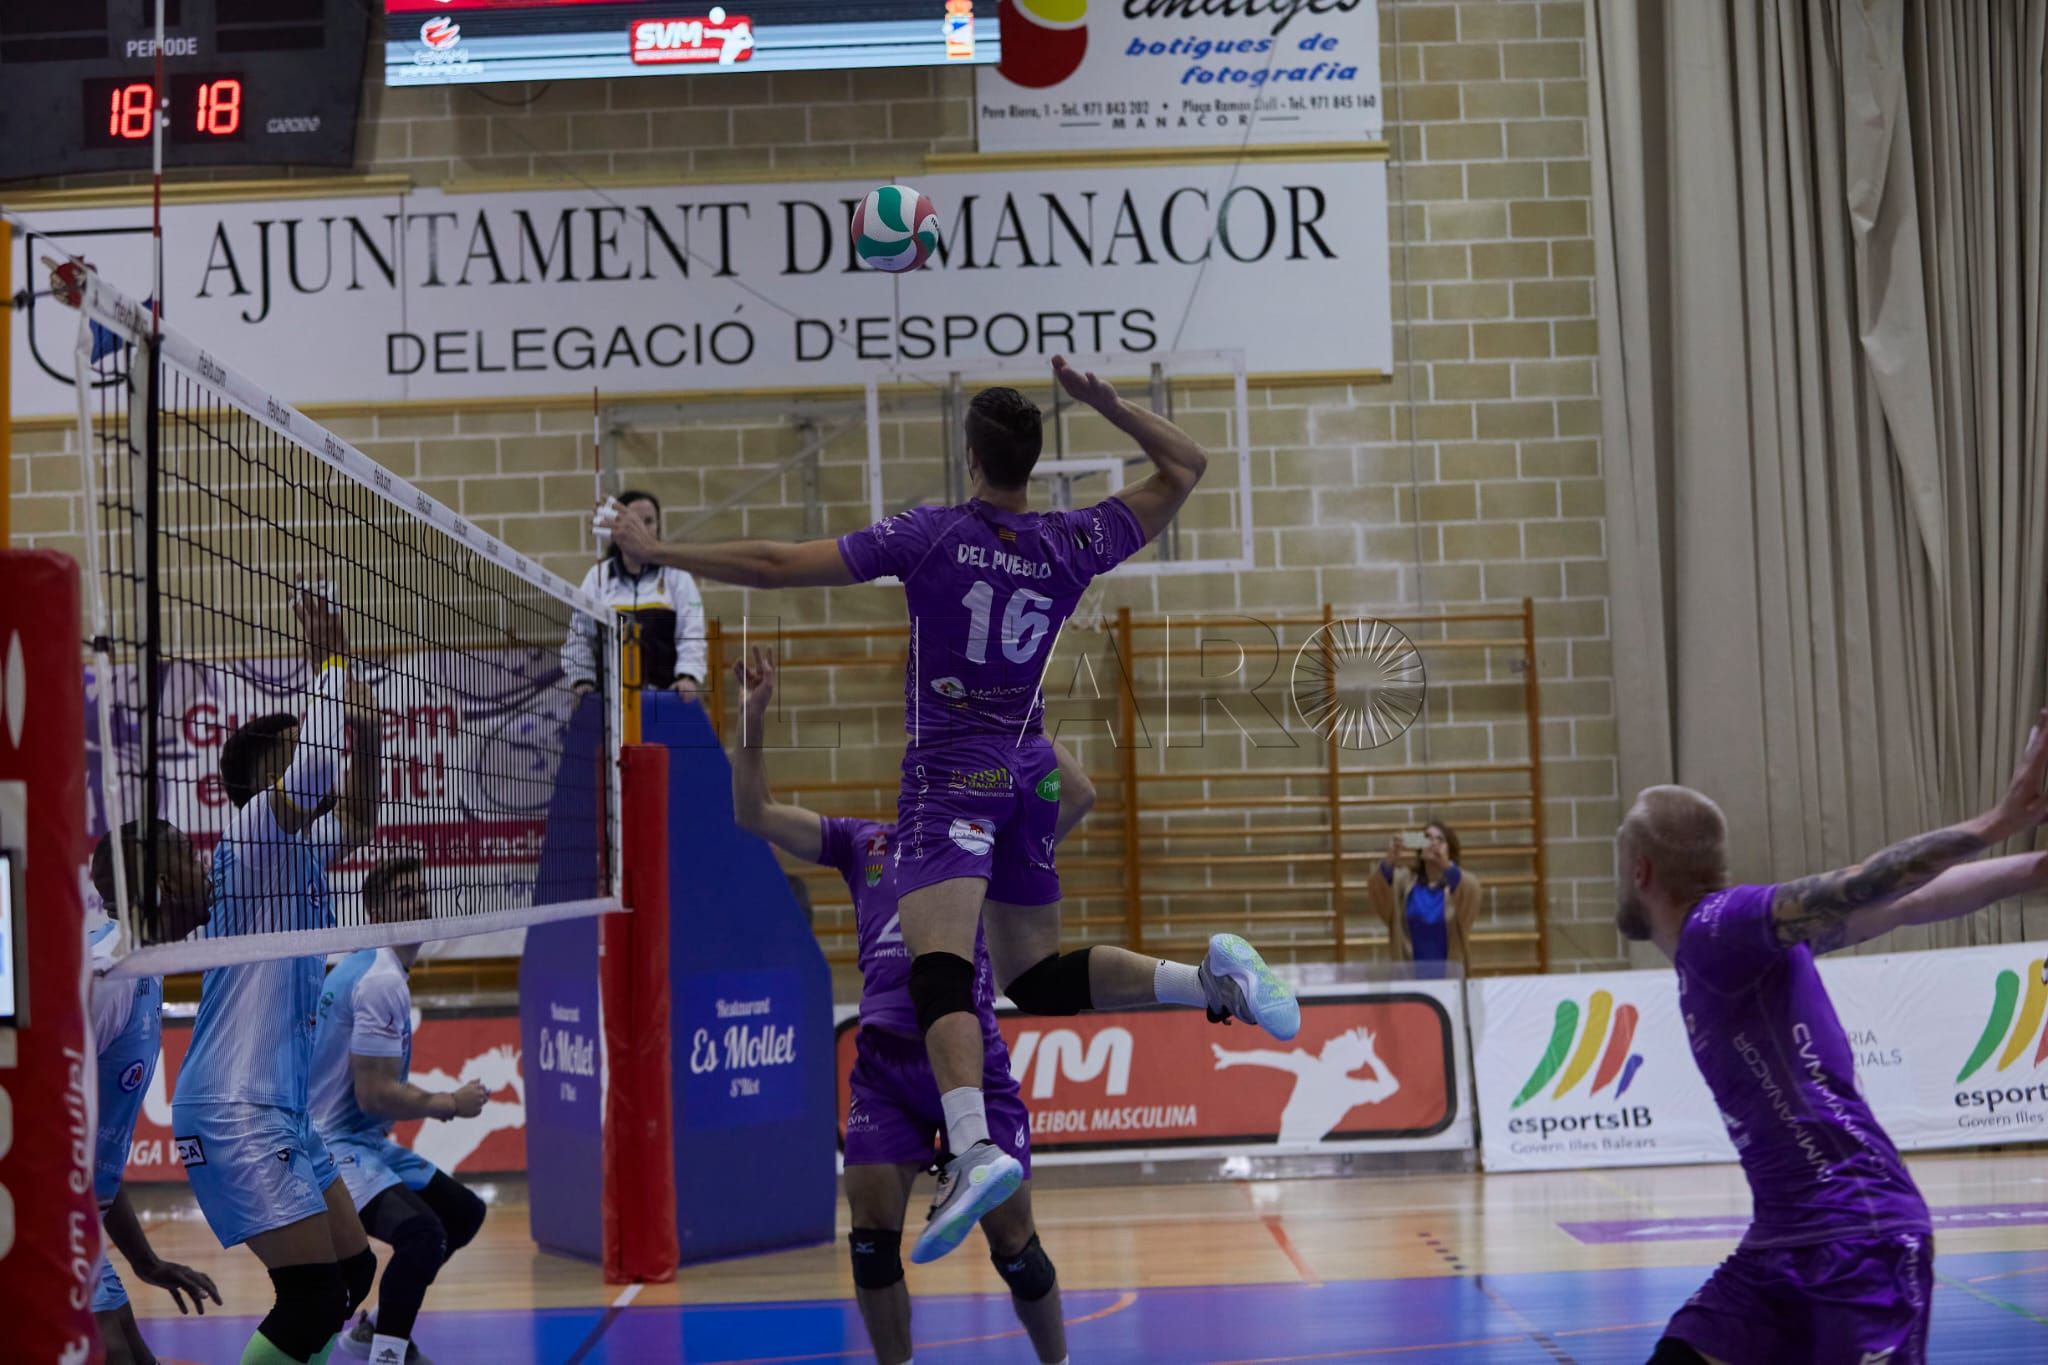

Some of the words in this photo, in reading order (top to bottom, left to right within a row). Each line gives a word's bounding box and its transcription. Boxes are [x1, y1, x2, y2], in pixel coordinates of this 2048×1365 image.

[635, 20, 703, 49] SVM
[1125, 36, 1273, 60] botigues
[1298, 32, 1339, 51] de
[1180, 62, 1358, 88] fotografia
[109, 83, 153, 139] 18
[196, 79, 241, 135] 18
[1084, 102, 1102, 116] 971
[1112, 114, 1248, 130] MANACOR
[195, 202, 751, 324] AJUNTAMENT
[387, 304, 756, 376] DELEGACIÓ
[795, 308, 1158, 362] D'ESPORTS
[957, 543, 990, 569] DEL
[992, 550, 1053, 580] PUEBLO
[961, 580, 1053, 665] 16
[690, 1027, 720, 1074] Es
[724, 1023, 796, 1071] Mollet
[1955, 1083, 2048, 1113] esport
[1029, 1109, 1089, 1134] LEIBOL
[1091, 1105, 1198, 1131] MASCULINA
[1508, 1105, 1653, 1141] esportsIB
[1958, 1112, 2012, 1129] Govern
[2016, 1110, 2045, 1125] Illes
[1602, 1136, 1657, 1150] Balears
